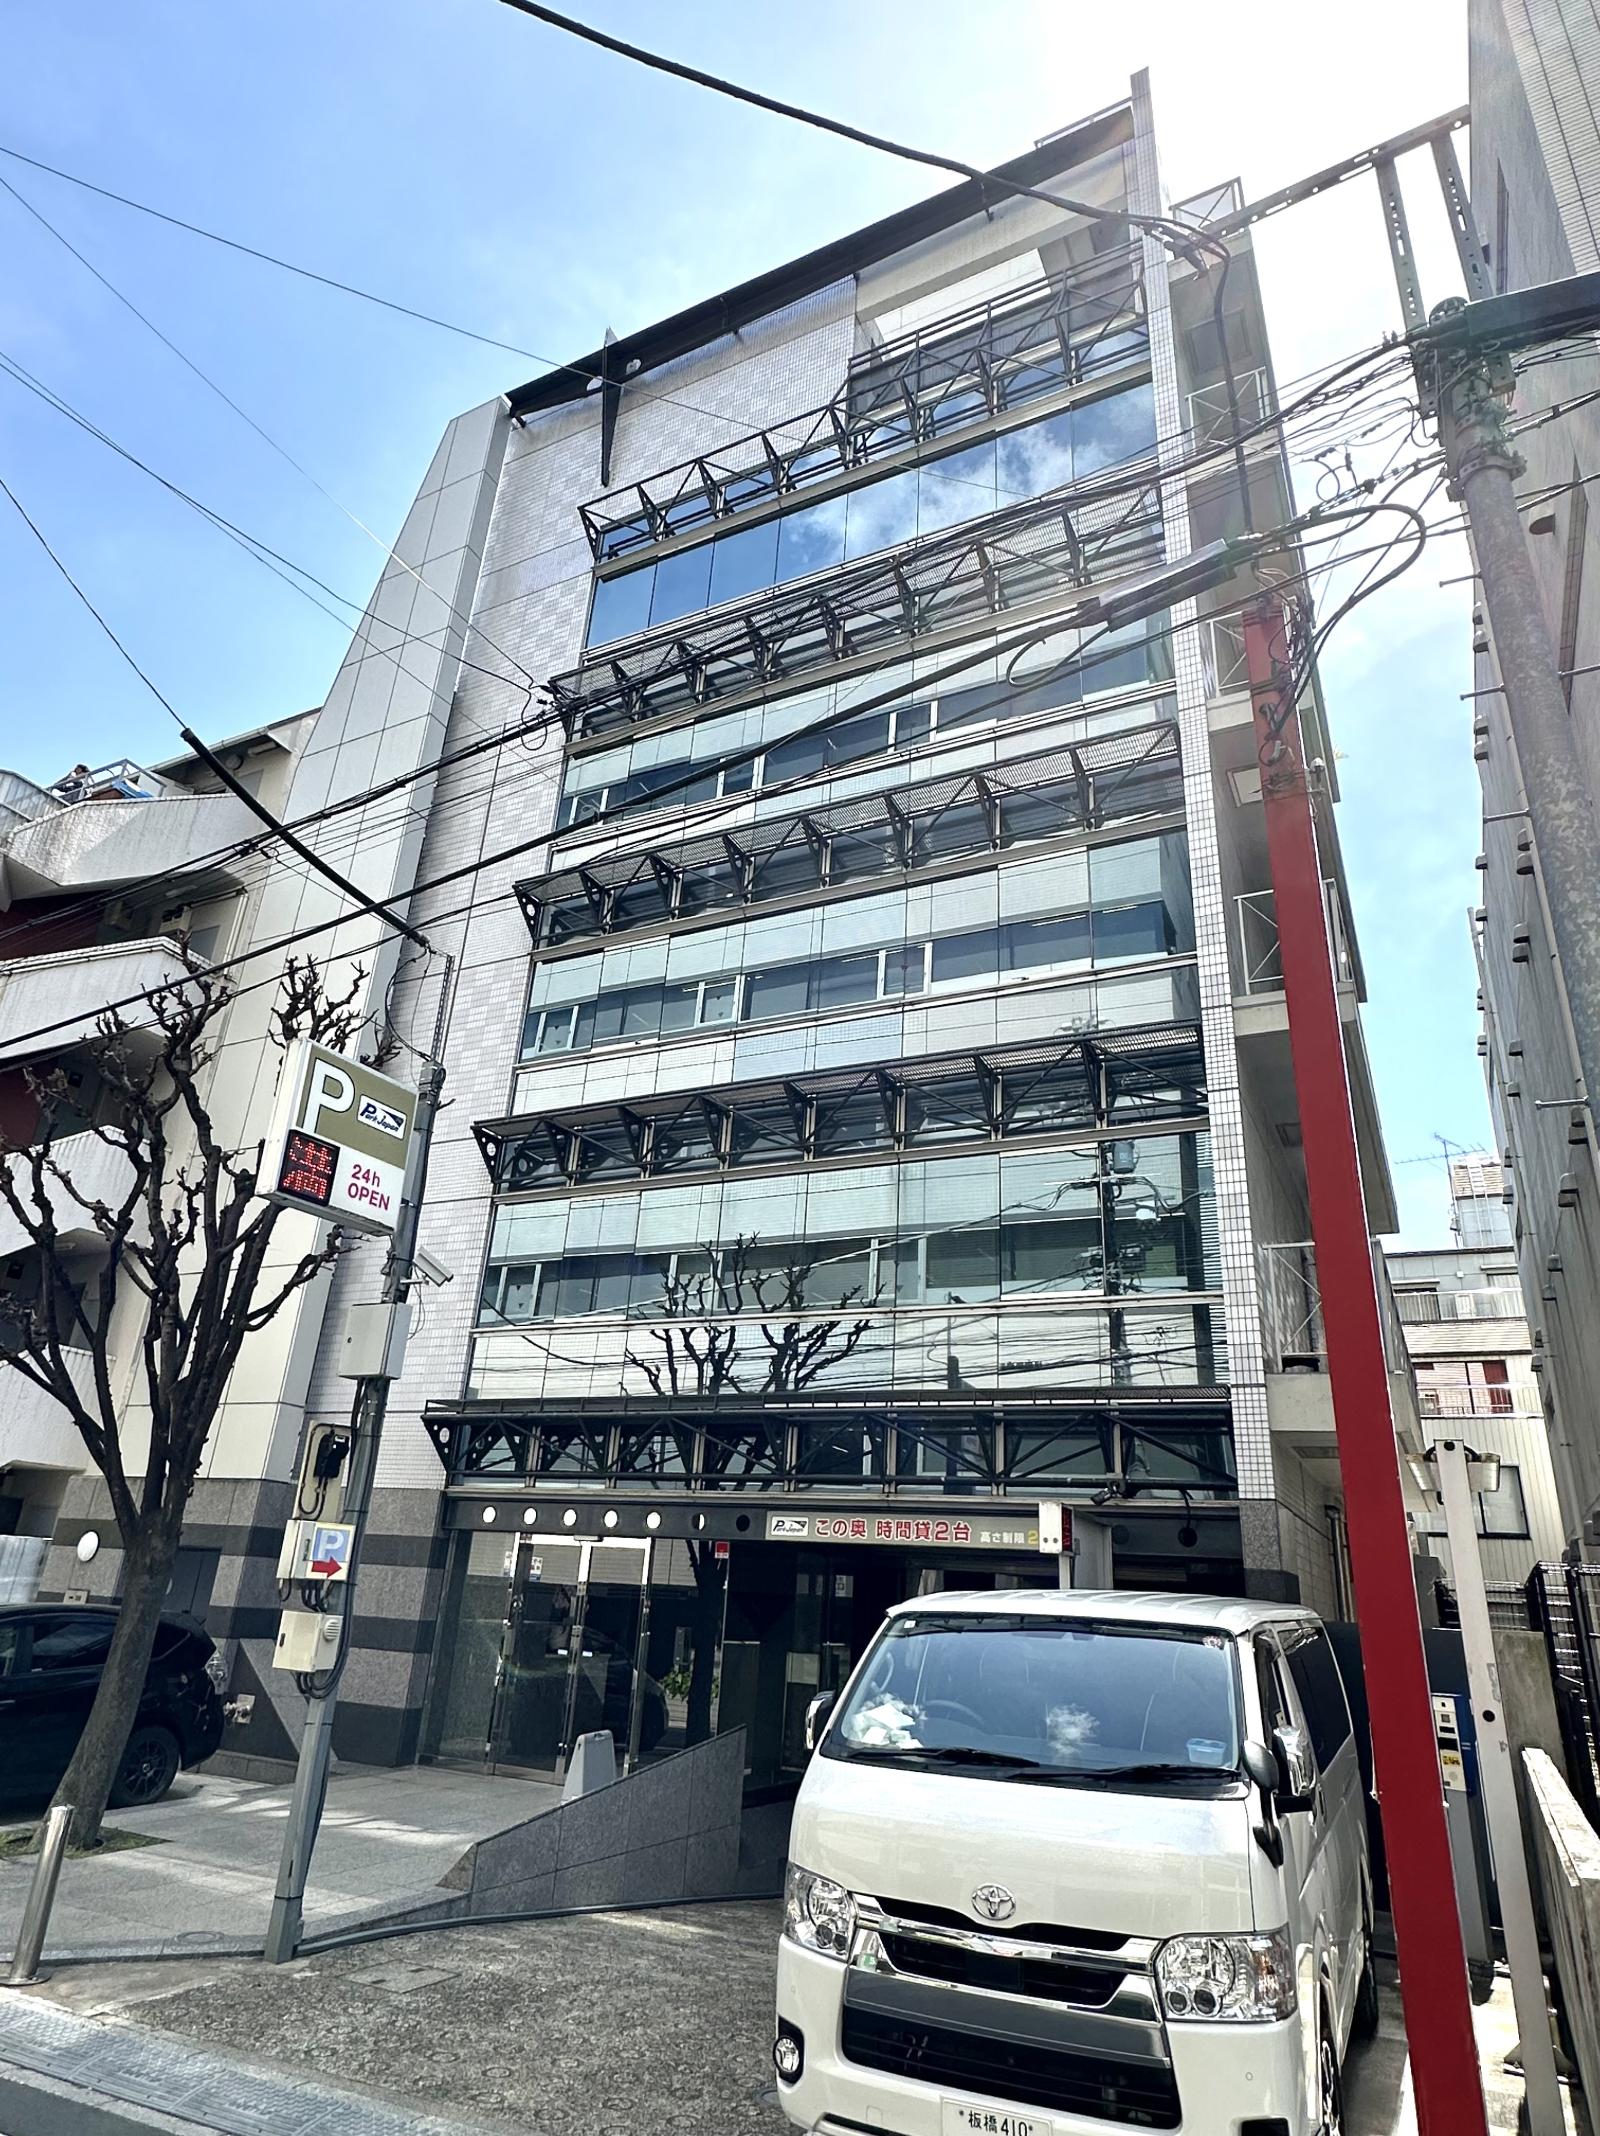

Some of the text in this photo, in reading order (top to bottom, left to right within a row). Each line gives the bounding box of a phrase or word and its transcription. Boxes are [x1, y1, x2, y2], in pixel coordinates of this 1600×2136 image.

[302, 1057, 355, 1133] P
[360, 1102, 399, 1132] Park Japan
[351, 1163, 380, 1188] 24h
[347, 1182, 390, 1211] OPEN
[318, 1530, 344, 1561] P
[816, 1519, 867, 1538] この奥
[876, 1519, 971, 1542] 時間貸2台
[980, 1531, 1025, 1544] 高さ制限
